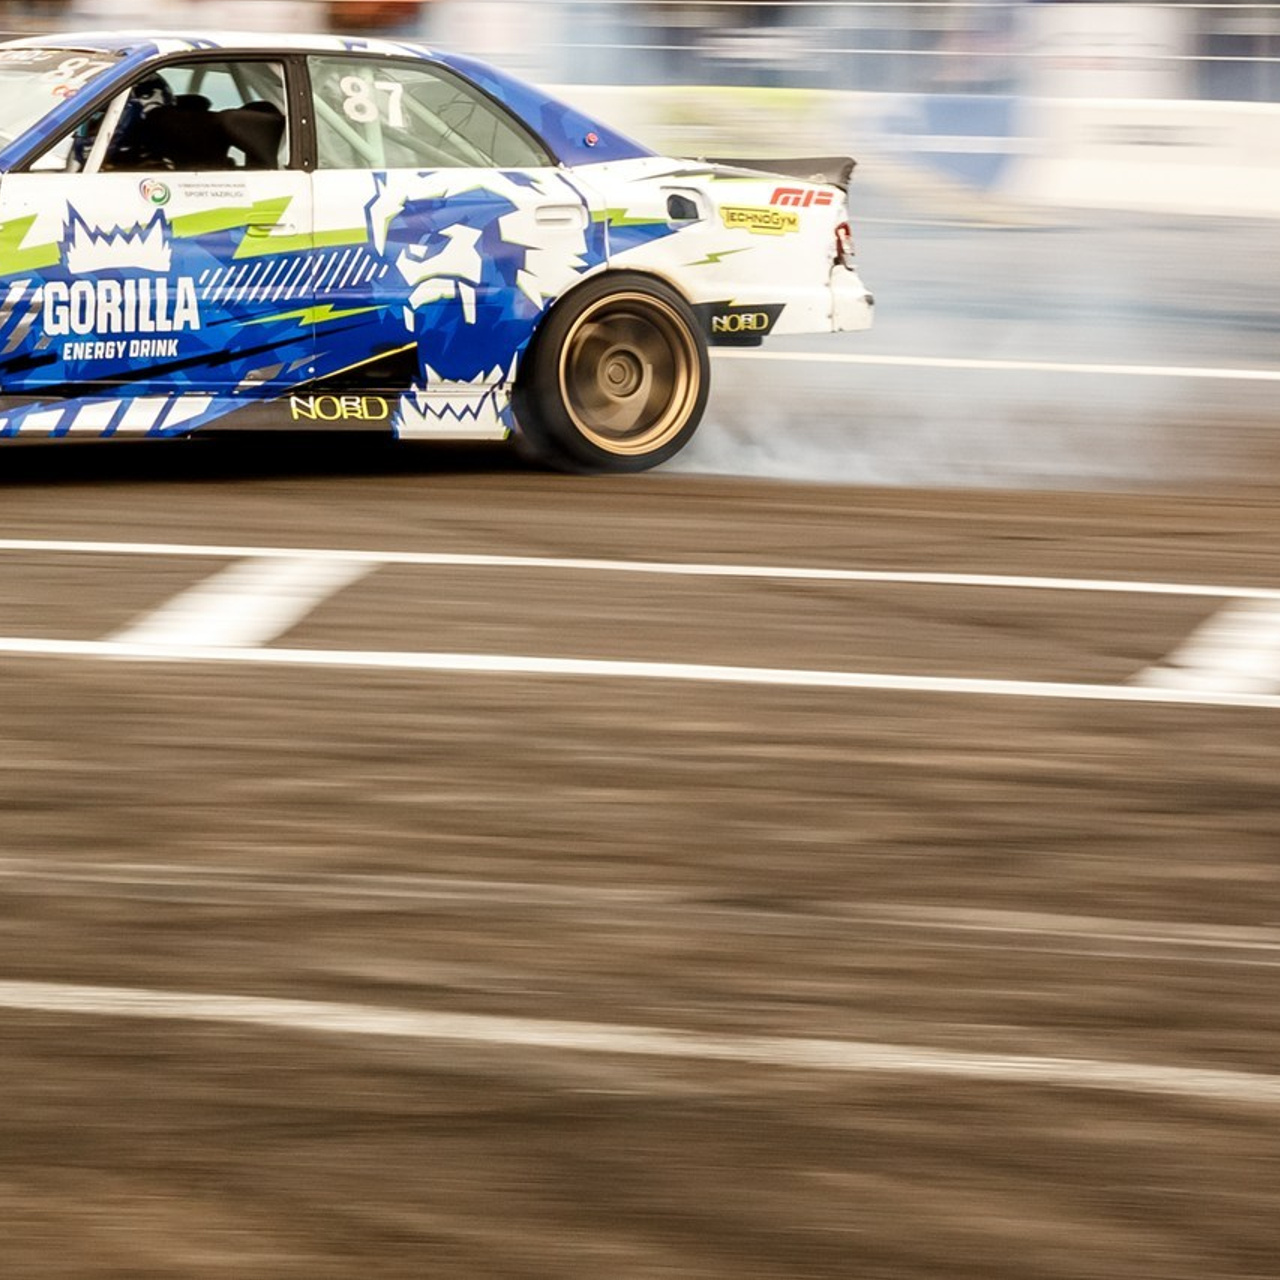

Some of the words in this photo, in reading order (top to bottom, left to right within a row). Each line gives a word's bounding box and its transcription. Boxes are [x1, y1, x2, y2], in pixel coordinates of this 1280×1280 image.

[46, 57, 116, 85] 87
[340, 76, 403, 127] 87
[43, 276, 201, 336] GORILLA
[712, 312, 769, 332] NORD
[63, 340, 127, 361] ENERGY
[129, 339, 179, 358] DRINK
[290, 395, 389, 420] NORD
